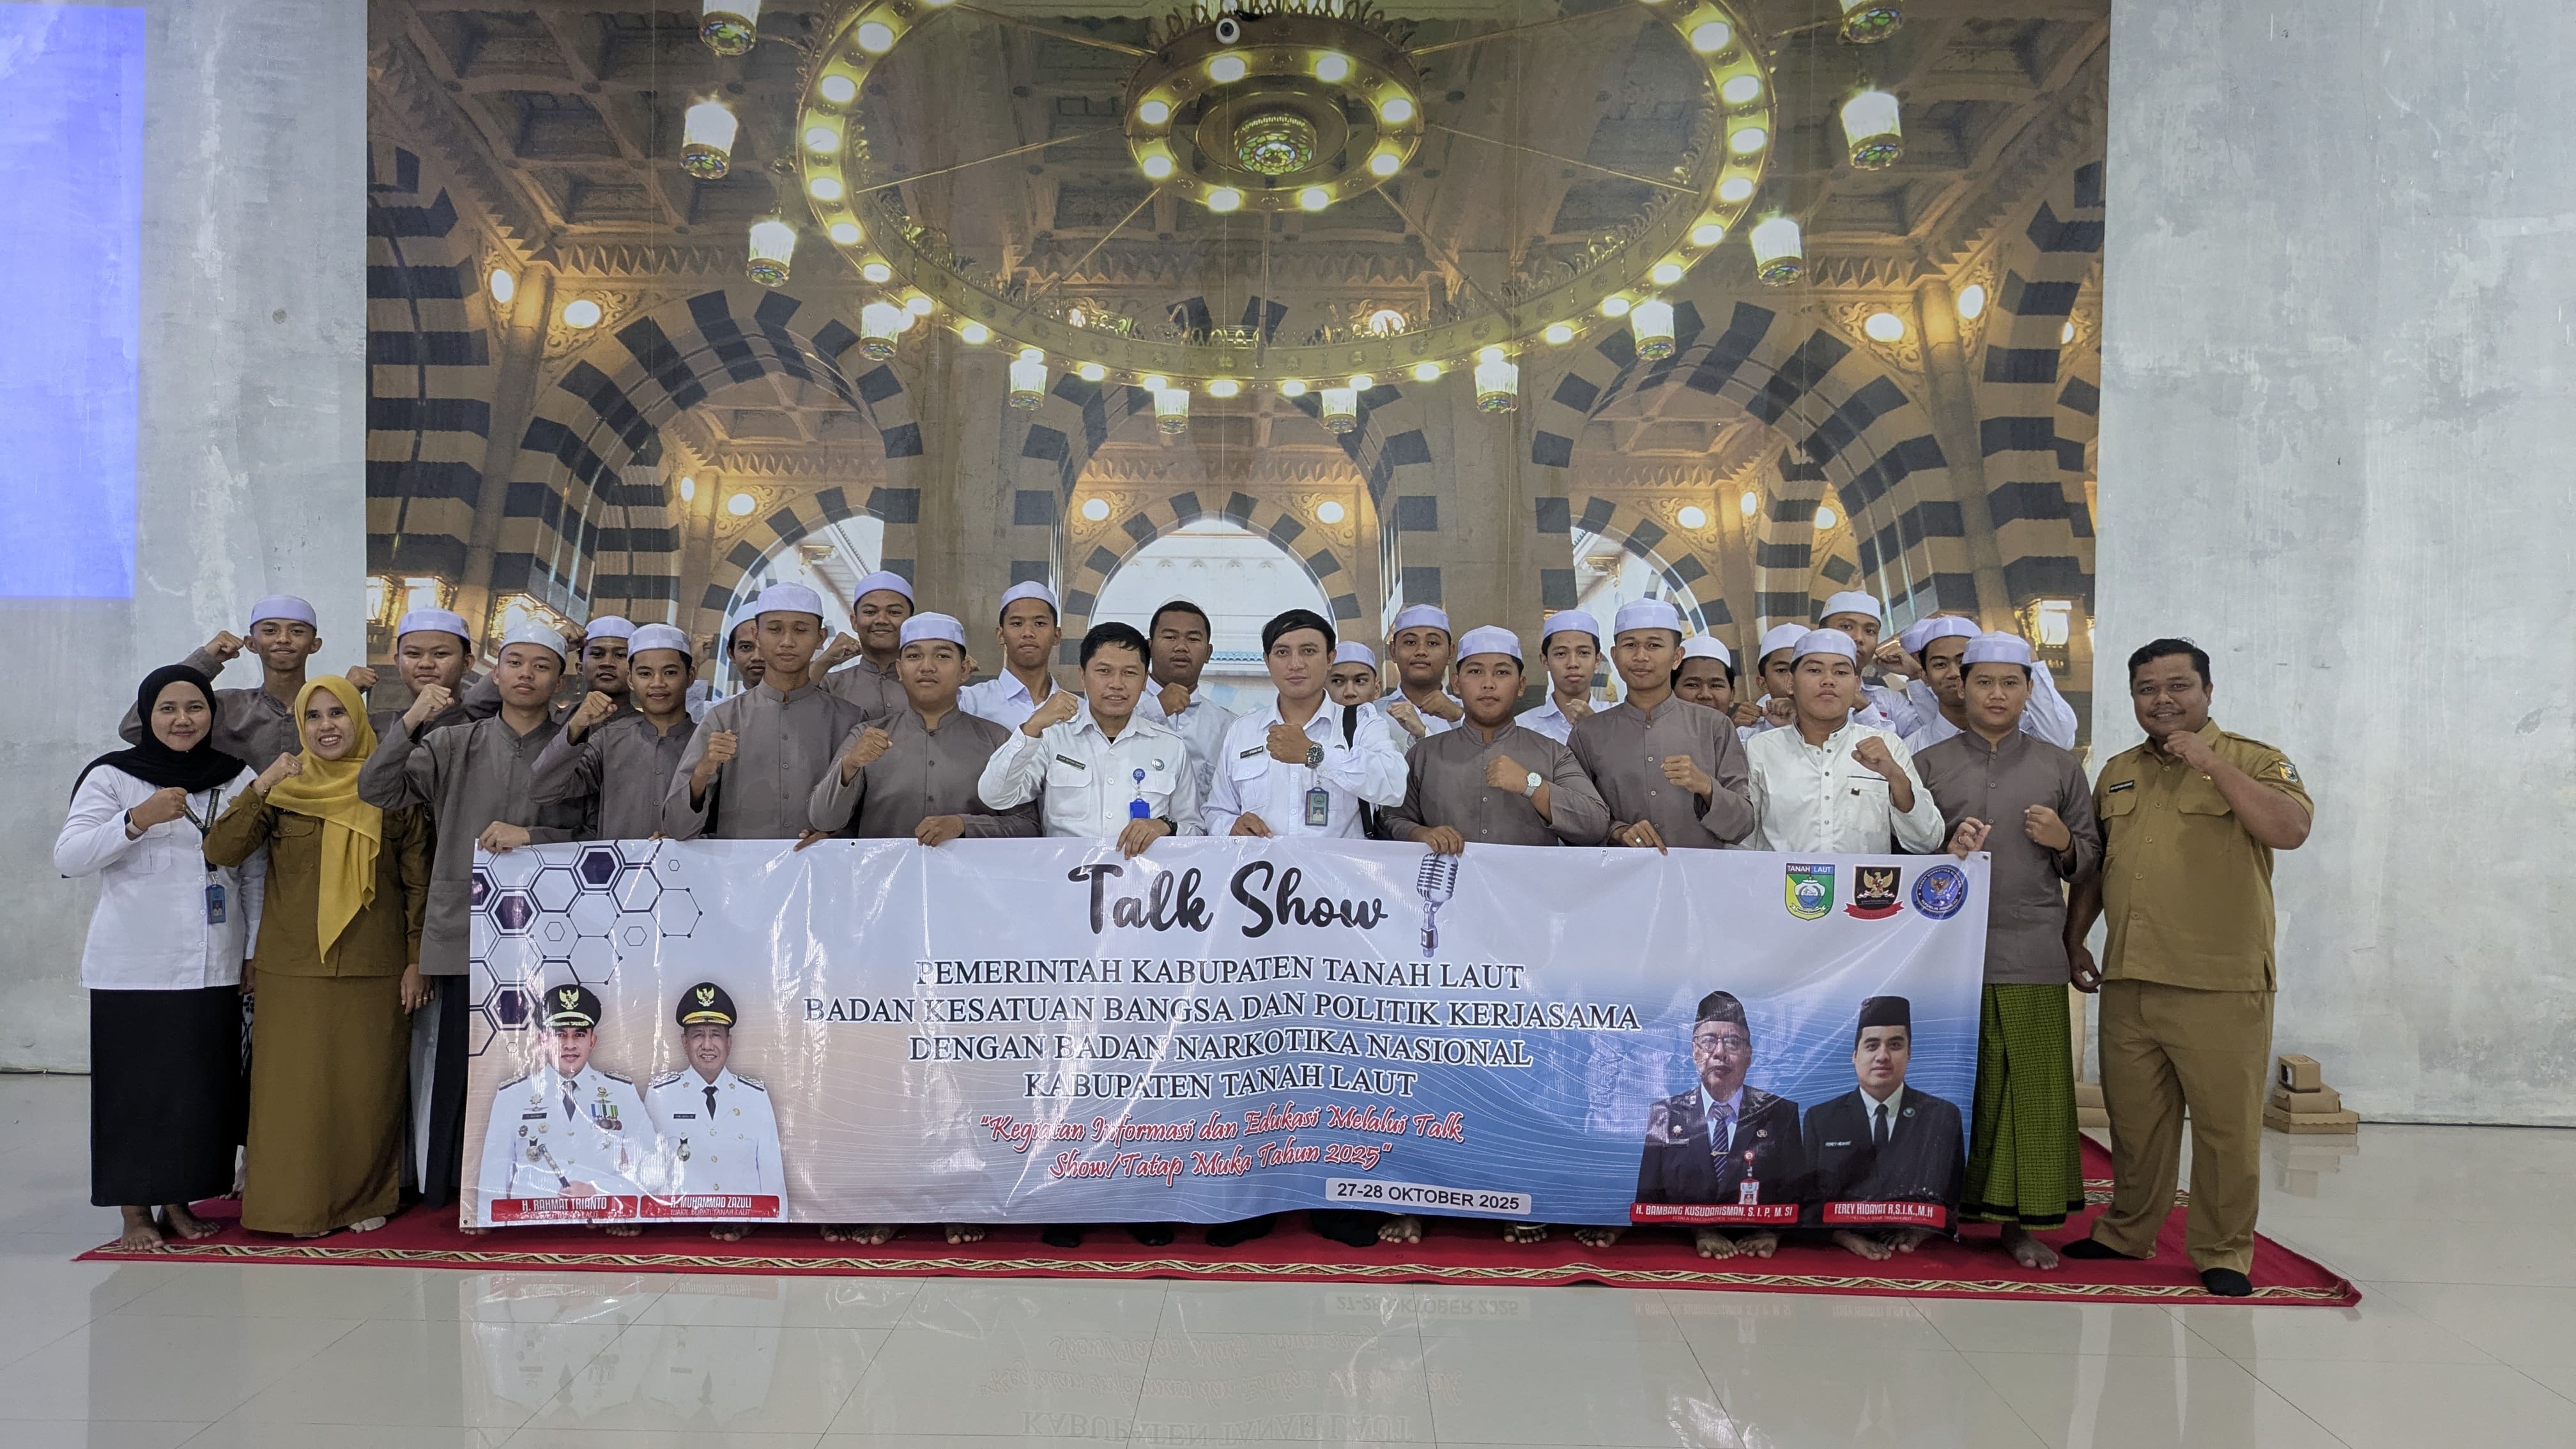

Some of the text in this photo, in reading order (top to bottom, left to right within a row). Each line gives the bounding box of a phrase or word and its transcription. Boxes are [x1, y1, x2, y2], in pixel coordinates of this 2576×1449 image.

[1068, 860, 1388, 938] Talk Show
[917, 956, 1524, 989] PEMERINTAH KABUPATEN TANAH LAUT
[804, 992, 1641, 1031] BADAN KESATUAN BANGSA DAN POLITIK KERJASAMA
[910, 1028, 1532, 1066] DENGAN BADAN NARKOTIKA NASIONAL
[1024, 1065, 1418, 1099] KABUPATEN TANAH LAUT
[1091, 1112, 1195, 1147] Informasi
[1198, 1111, 1238, 1141] dan
[1244, 1101, 1320, 1137] Edukasi
[1326, 1104, 1408, 1135] Melalui
[1413, 1112, 1465, 1143] Talk
[1049, 1149, 1184, 1188] Show/Tatap
[1191, 1147, 1252, 1177] Muka
[1257, 1136, 1320, 1168] Tahun
[522, 1197, 607, 1211] H. RAHMAT TRIANTO
[680, 1197, 725, 1208] MUHAMMAD
[728, 1196, 752, 1208] ZAZULI
[1337, 1183, 1519, 1209] 27-28 OKTOBER 2025
[1636, 1205, 1643, 1215] H.
[1646, 1205, 1682, 1215] BAMBANG
[1834, 1204, 1855, 1215] FEREY
[1857, 1204, 1886, 1215] HIDAYAT
